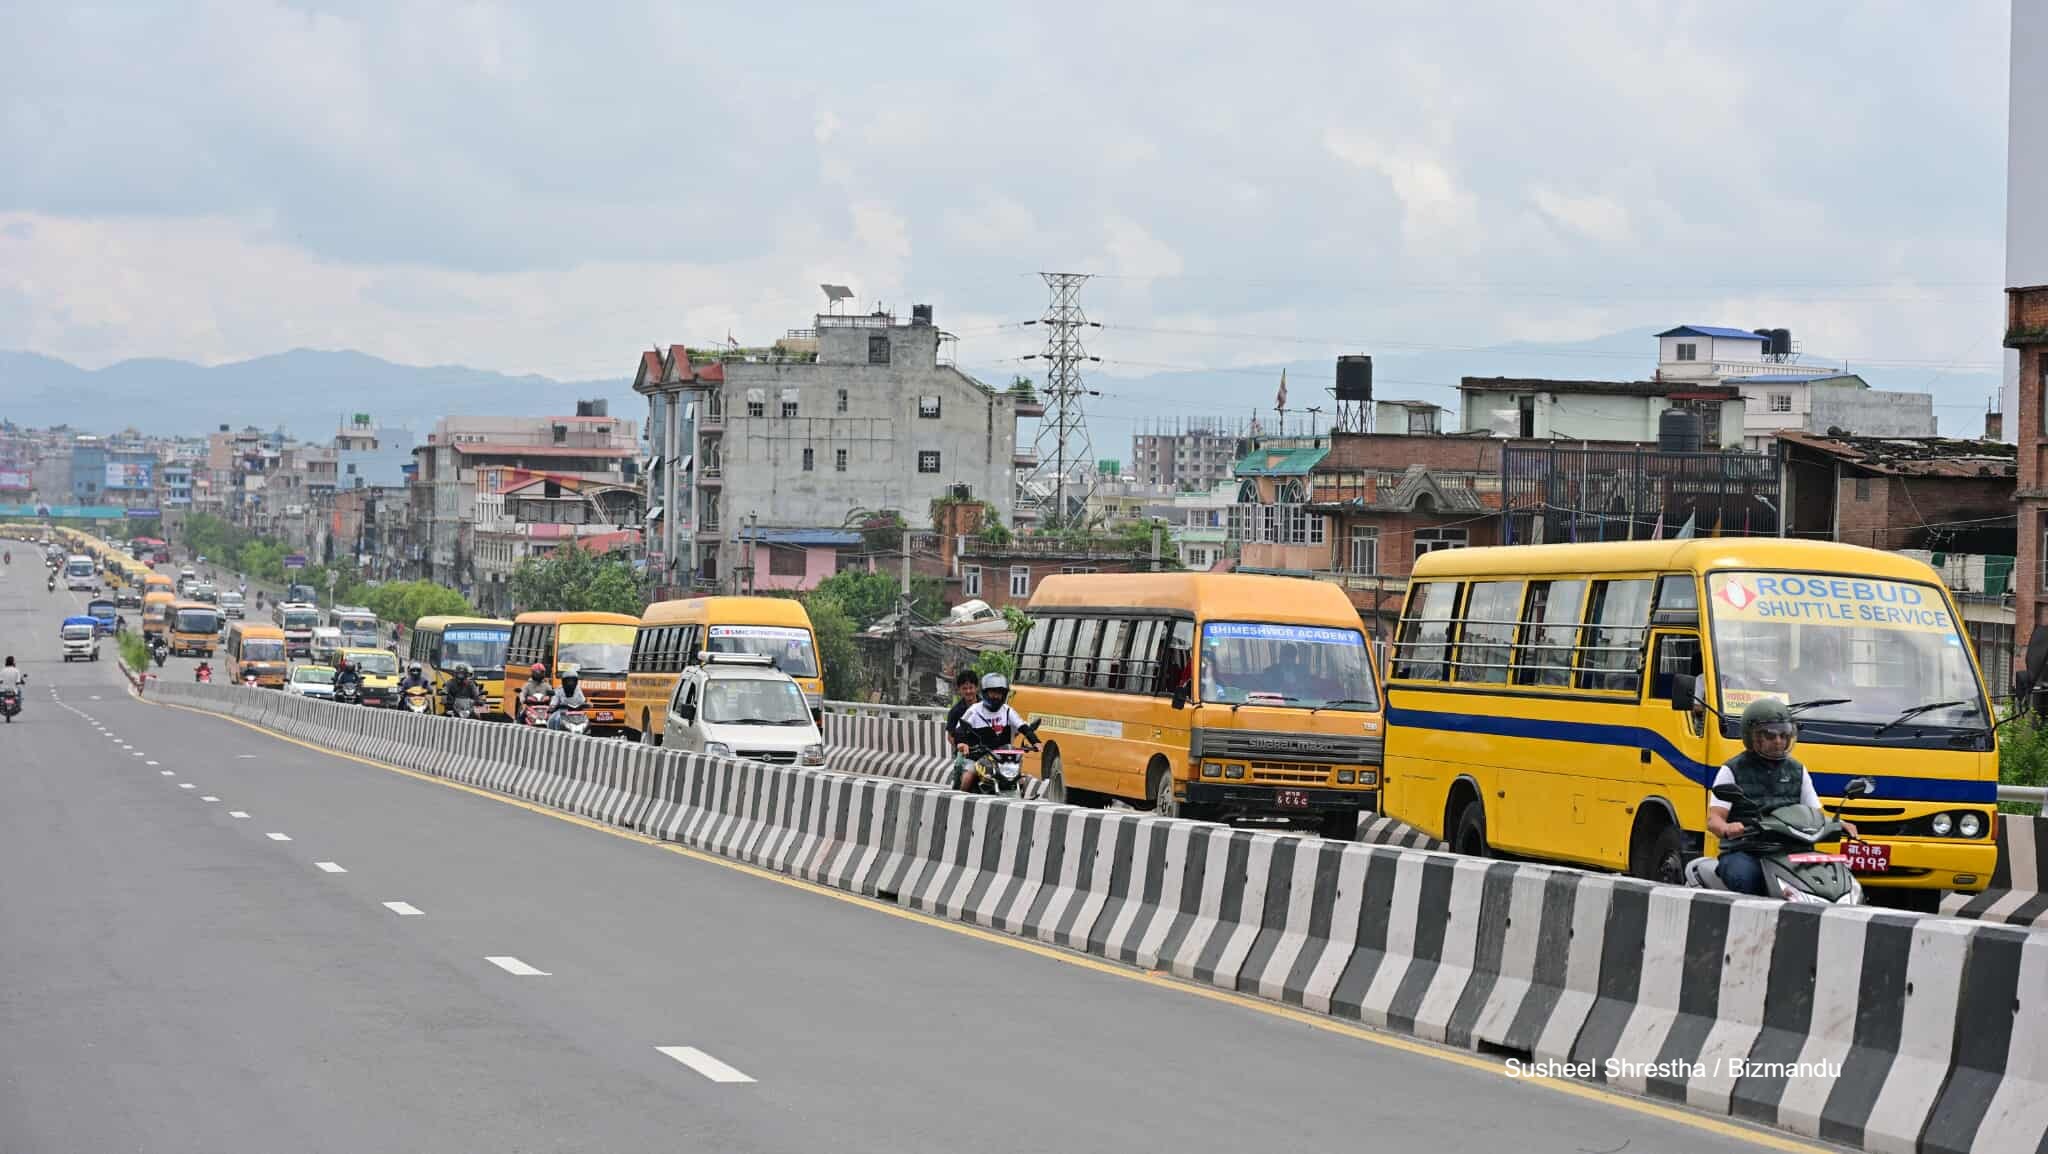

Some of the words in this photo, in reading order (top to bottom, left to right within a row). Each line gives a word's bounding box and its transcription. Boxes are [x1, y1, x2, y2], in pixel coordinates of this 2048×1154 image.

[1757, 577, 1921, 605] ROSEBUD
[1758, 600, 1855, 621] SHUTTLE
[1859, 604, 1949, 628] SERVICE
[1209, 625, 1294, 638] BHIMESHWOR
[1299, 630, 1355, 642] ACADEMY
